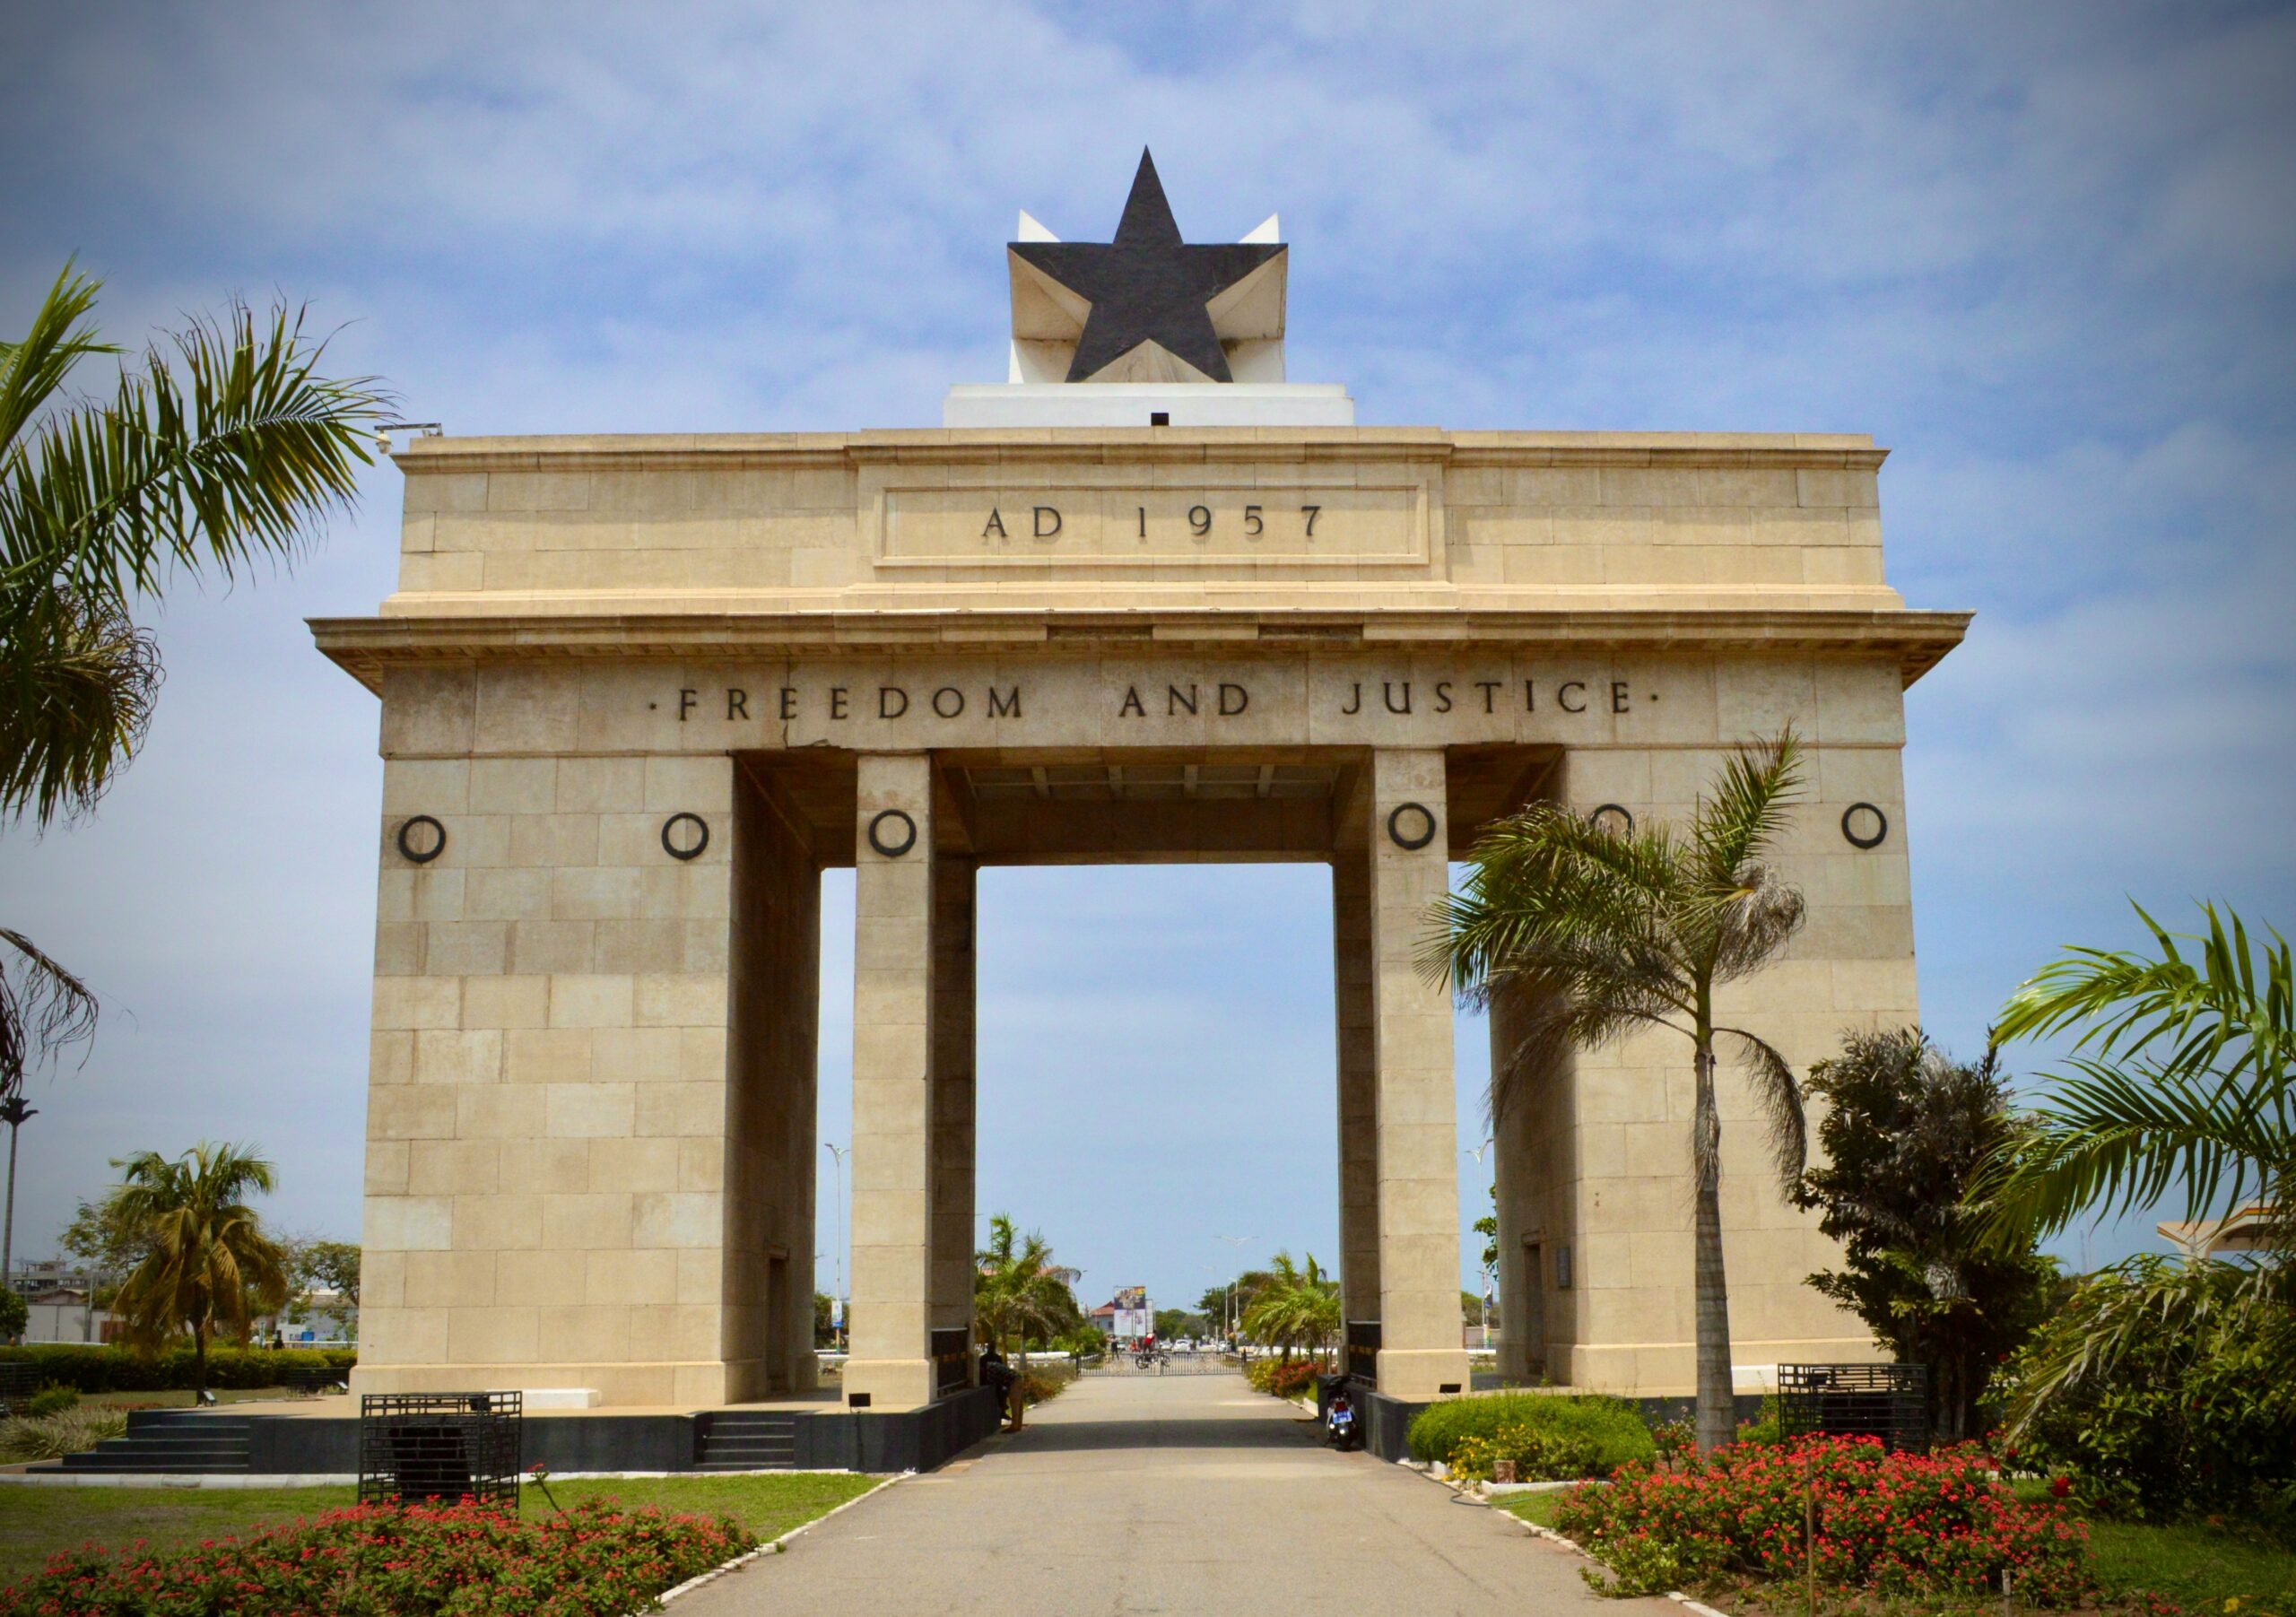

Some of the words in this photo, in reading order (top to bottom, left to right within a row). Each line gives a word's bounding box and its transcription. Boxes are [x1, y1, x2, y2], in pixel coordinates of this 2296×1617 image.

[982, 506, 1062, 539] AD
[1138, 505, 1322, 538] 1957
[679, 686, 1022, 722] FREEDOM
[1118, 683, 1249, 718] AND
